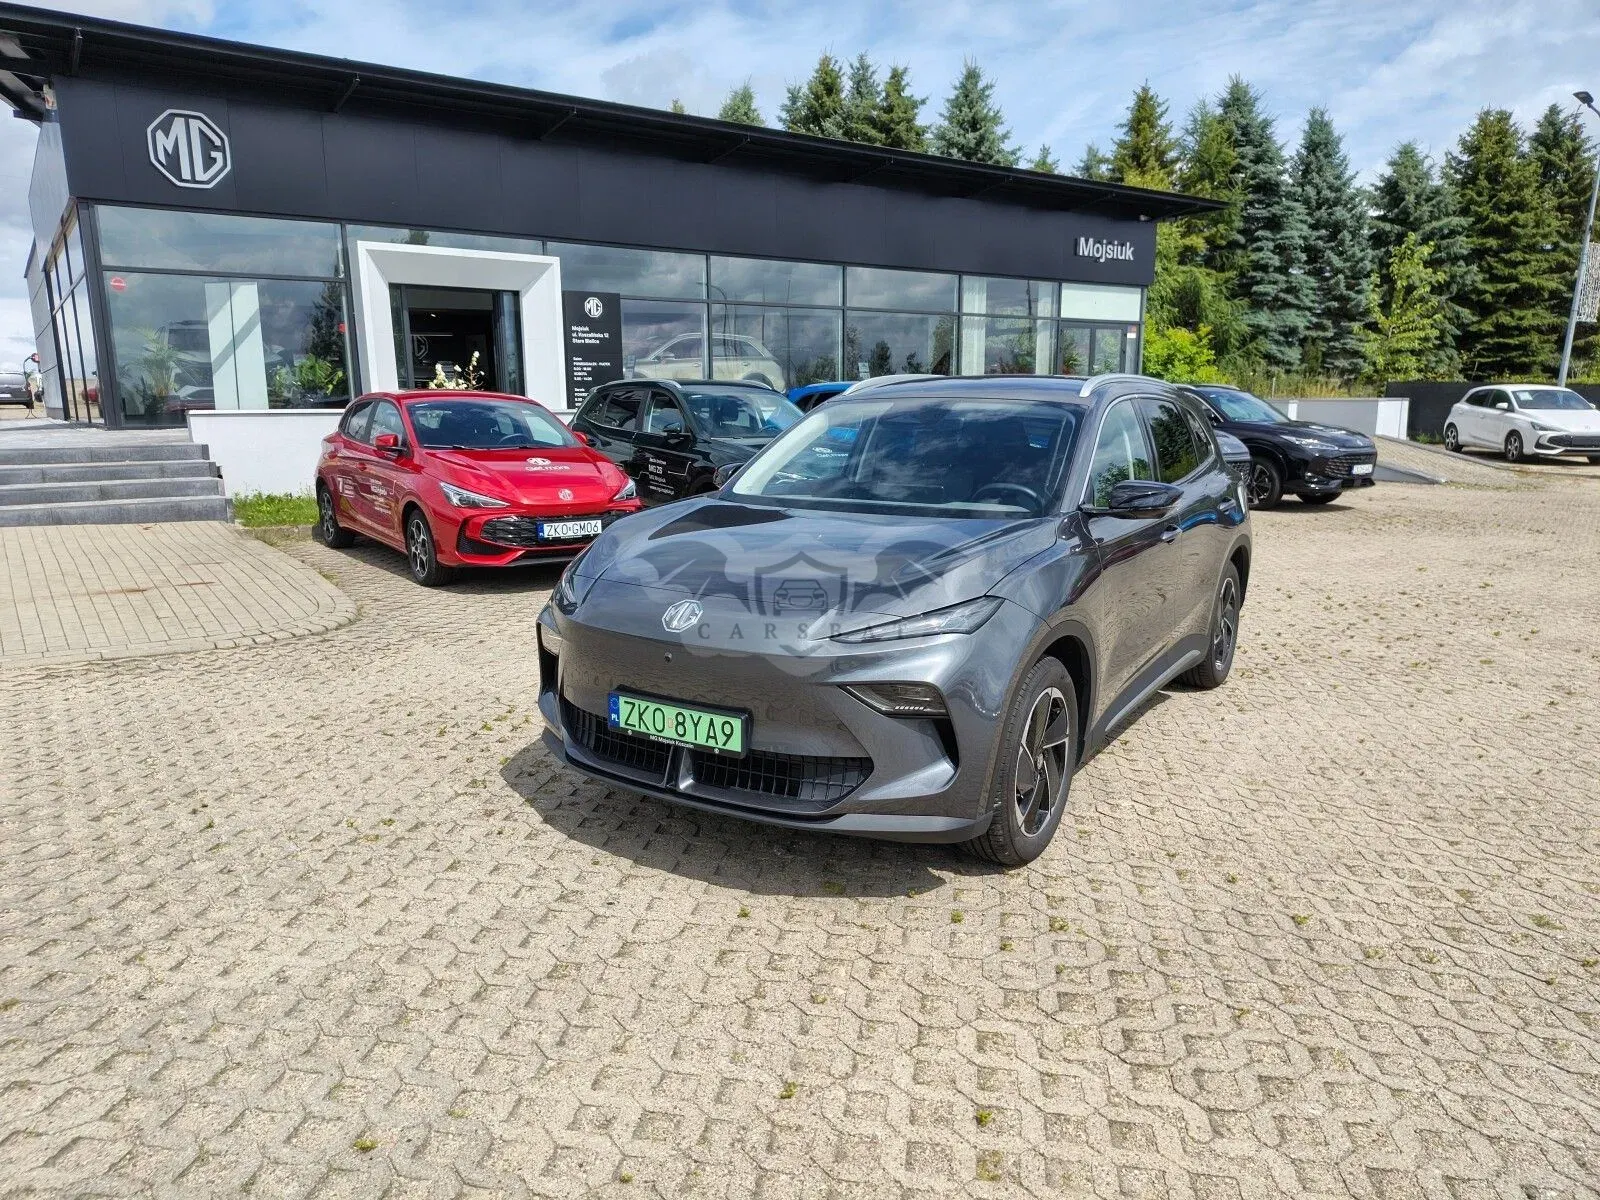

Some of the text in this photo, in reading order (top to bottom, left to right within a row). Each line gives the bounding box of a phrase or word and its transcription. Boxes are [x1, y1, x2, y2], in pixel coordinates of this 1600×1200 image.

[153, 115, 225, 183] MG
[1079, 237, 1134, 262] Mojsiuk
[586, 298, 602, 317] MG
[546, 521, 599, 537] ZKO GM06
[663, 601, 701, 631] MG
[623, 701, 735, 746] ZKO 8YA9
